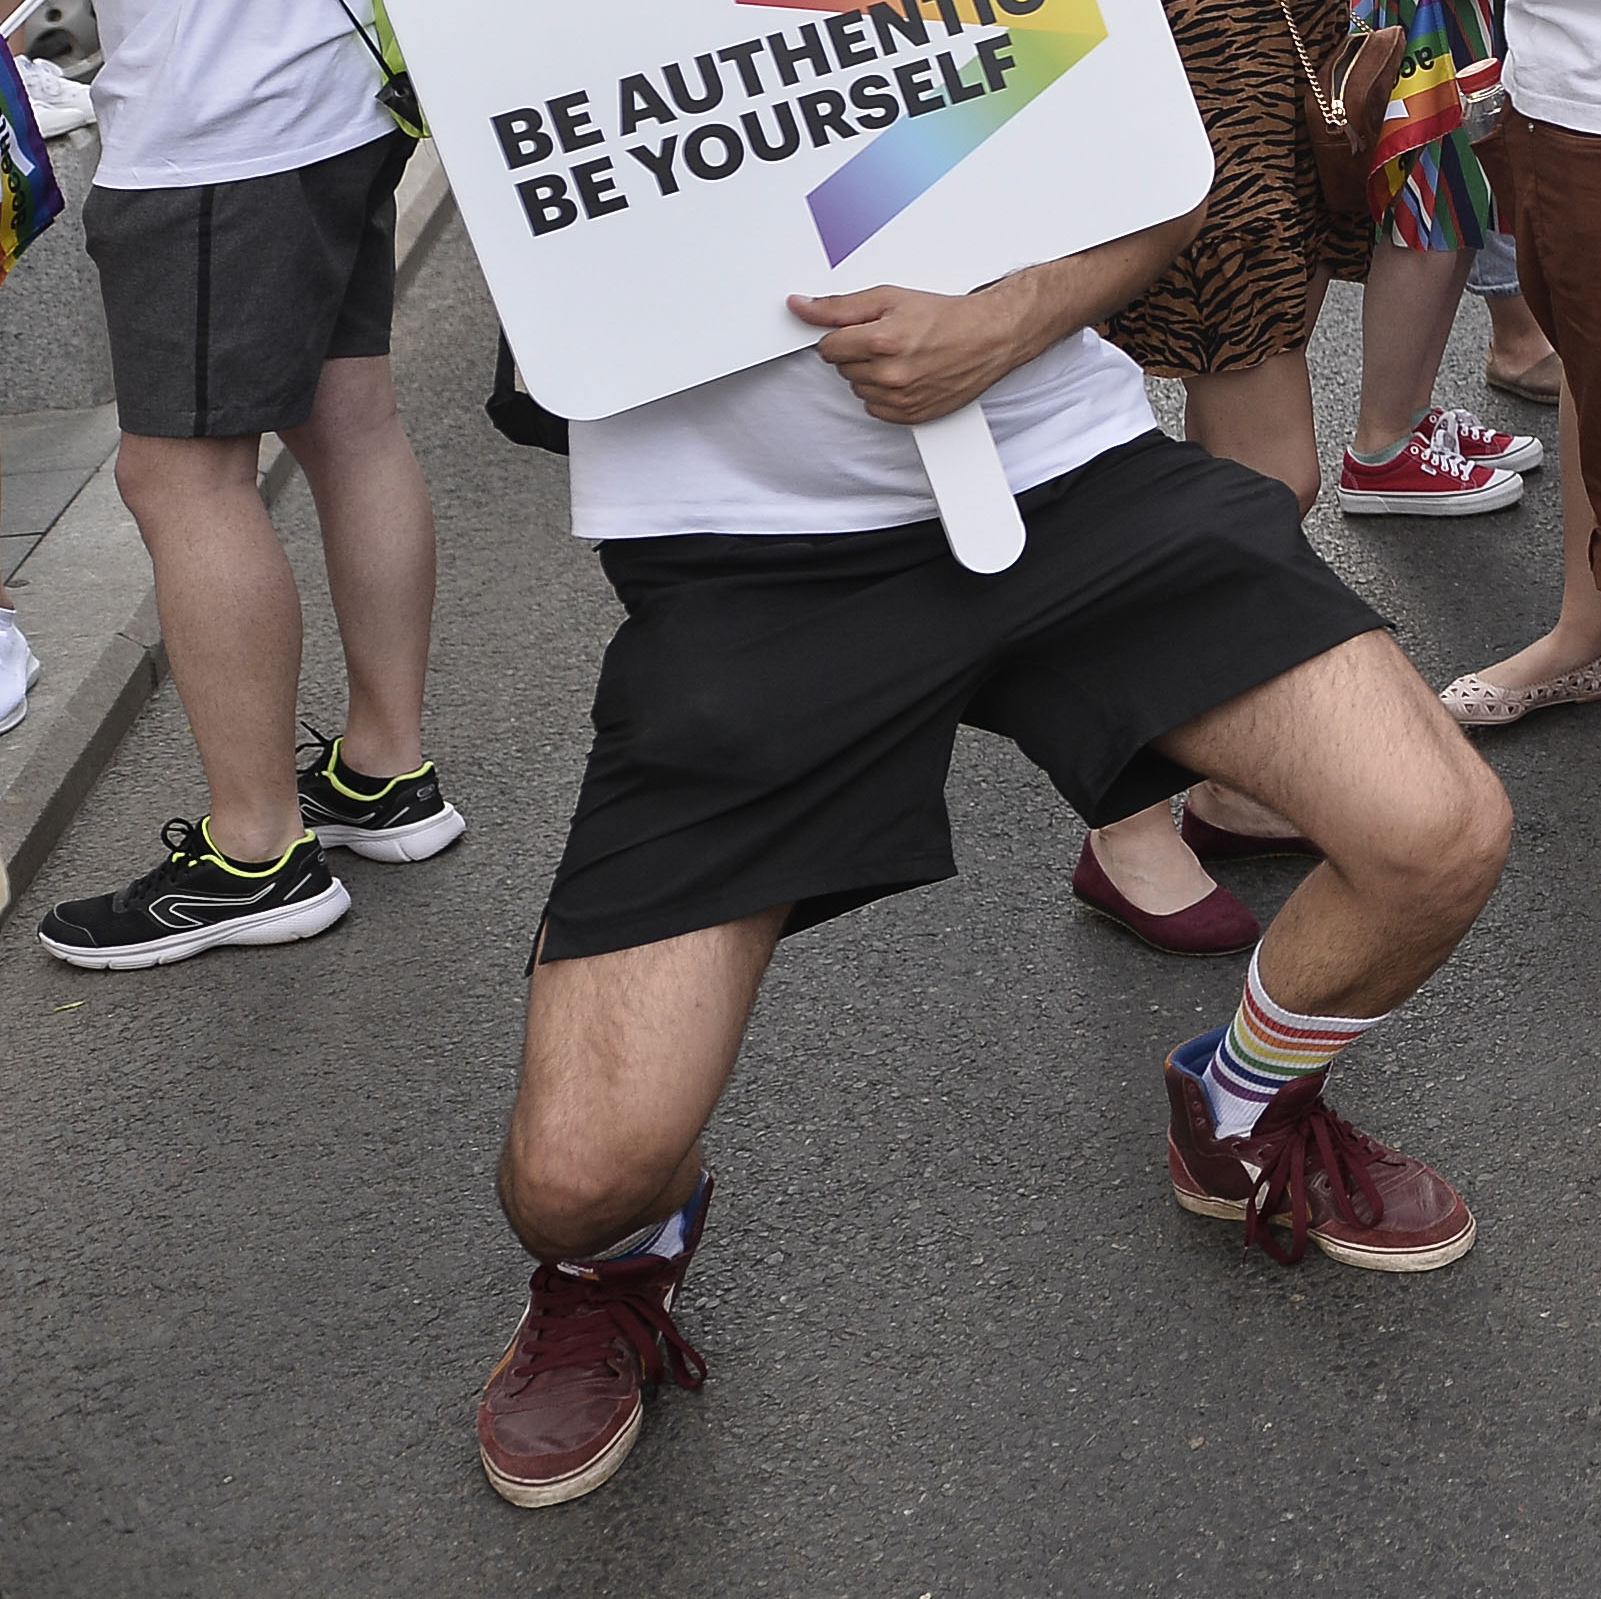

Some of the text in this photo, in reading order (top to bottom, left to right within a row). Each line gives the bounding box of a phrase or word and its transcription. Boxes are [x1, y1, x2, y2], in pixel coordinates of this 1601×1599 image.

[490, 90, 604, 170] BE
[515, 33, 1016, 236] BE YOURSELF
